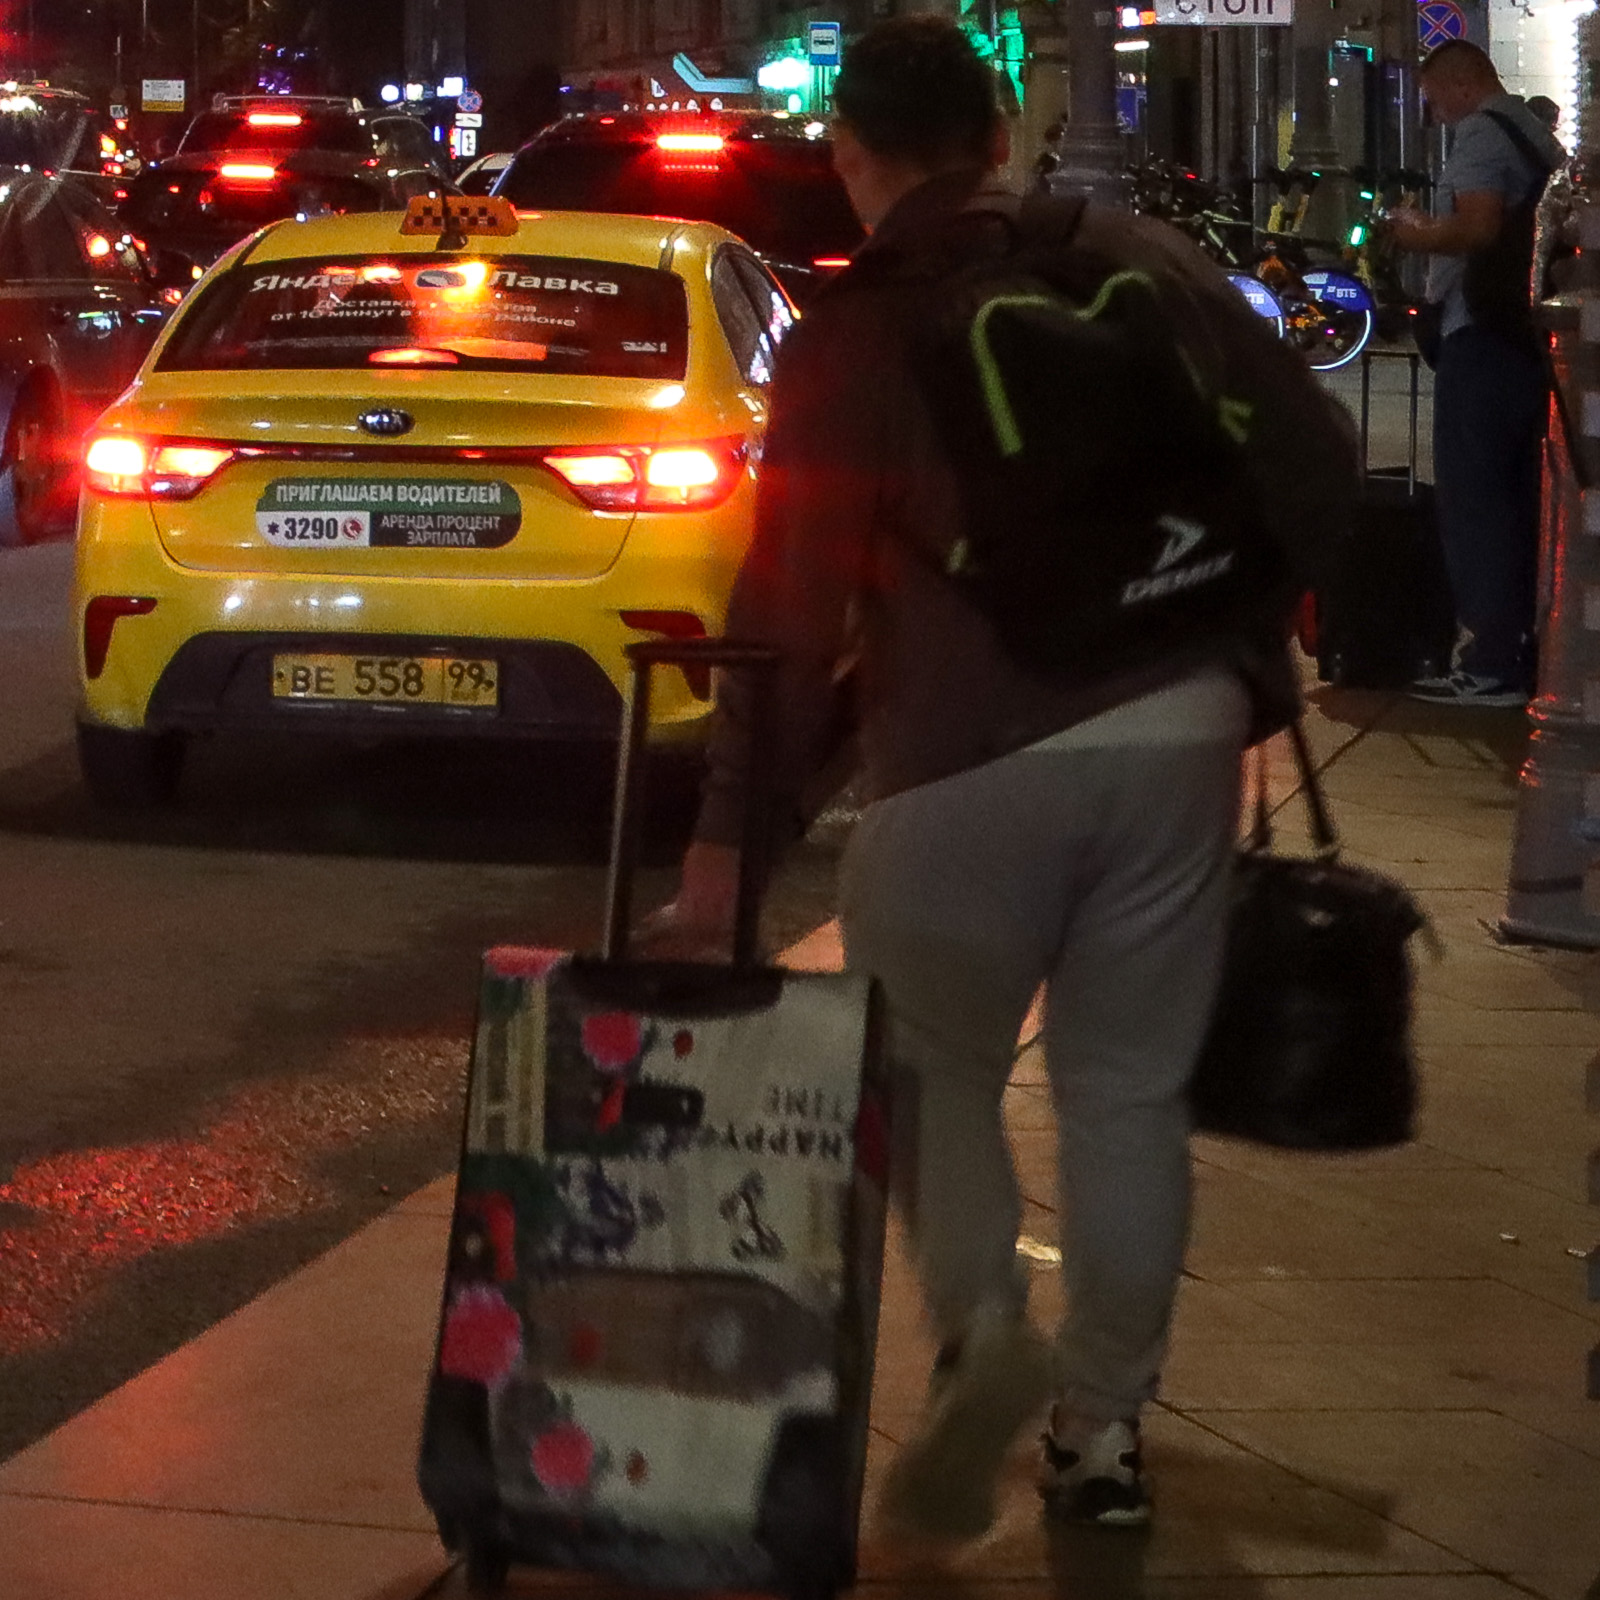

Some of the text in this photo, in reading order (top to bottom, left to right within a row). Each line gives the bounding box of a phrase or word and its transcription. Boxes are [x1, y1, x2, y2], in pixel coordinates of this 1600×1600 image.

[249, 268, 404, 293] Янде
[275, 482, 502, 506] ПРИГЛАШАЕМ ВОДИТЕЛЕЙ
[380, 514, 501, 532] АРЕНДА ПРОЦЕНТ
[405, 530, 477, 547] ЗАРПЛАТА
[291, 659, 486, 698] ВЕ 558 99
